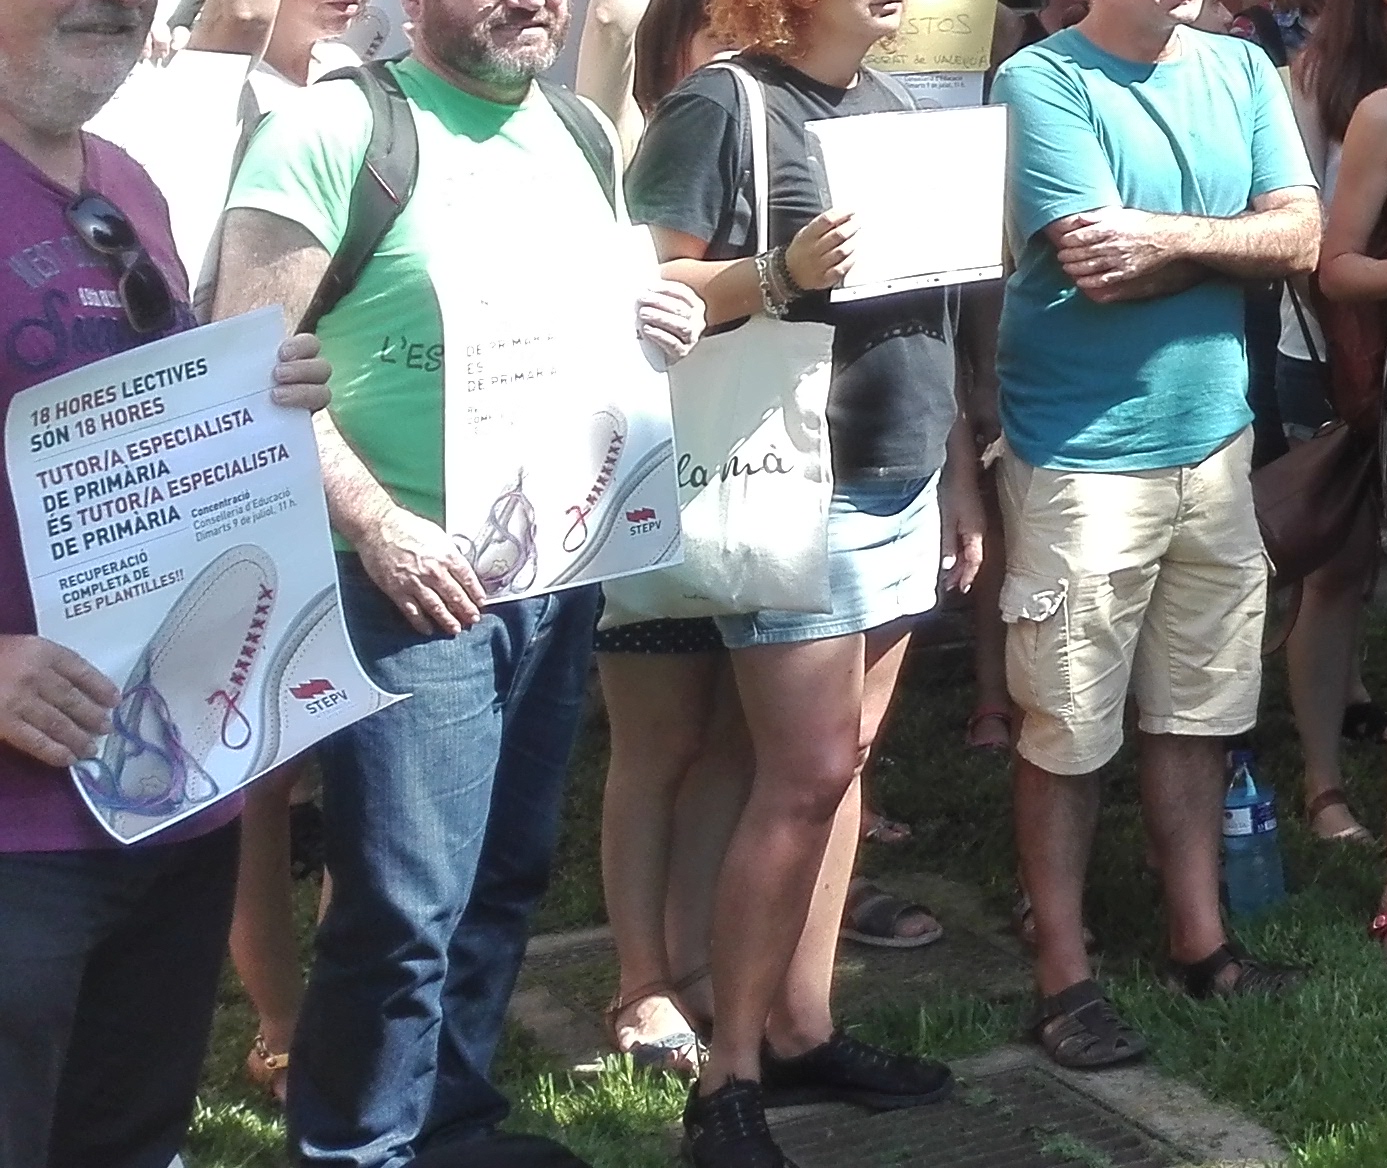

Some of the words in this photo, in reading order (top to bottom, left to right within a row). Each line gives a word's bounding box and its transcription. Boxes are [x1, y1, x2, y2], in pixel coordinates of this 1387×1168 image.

[904, 13, 972, 35] STOS
[30, 406, 51, 428] 18
[55, 385, 118, 420] HORES
[121, 358, 209, 400] LECTIVES
[29, 420, 71, 453] SÓN
[76, 417, 98, 438] 18
[101, 396, 166, 431] HORES
[38, 447, 123, 490] TUTOR/A
[127, 407, 253, 462] ESPECIALISTA
[43, 490, 70, 514] DE
[72, 452, 168, 504] PRIMÀRIA
[46, 508, 74, 538] ÉS
[78, 484, 162, 528] TUTOR/A
[166, 443, 290, 499] ESPECIALISTA
[52, 537, 80, 561] DE
[82, 498, 178, 551] PRIMÀRIA
[630, 520, 662, 536] STEPV
[63, 573, 131, 606] COMPLETA
[133, 566, 149, 582] DE
[66, 601, 94, 620] LES
[305, 689, 348, 714] STEPV
